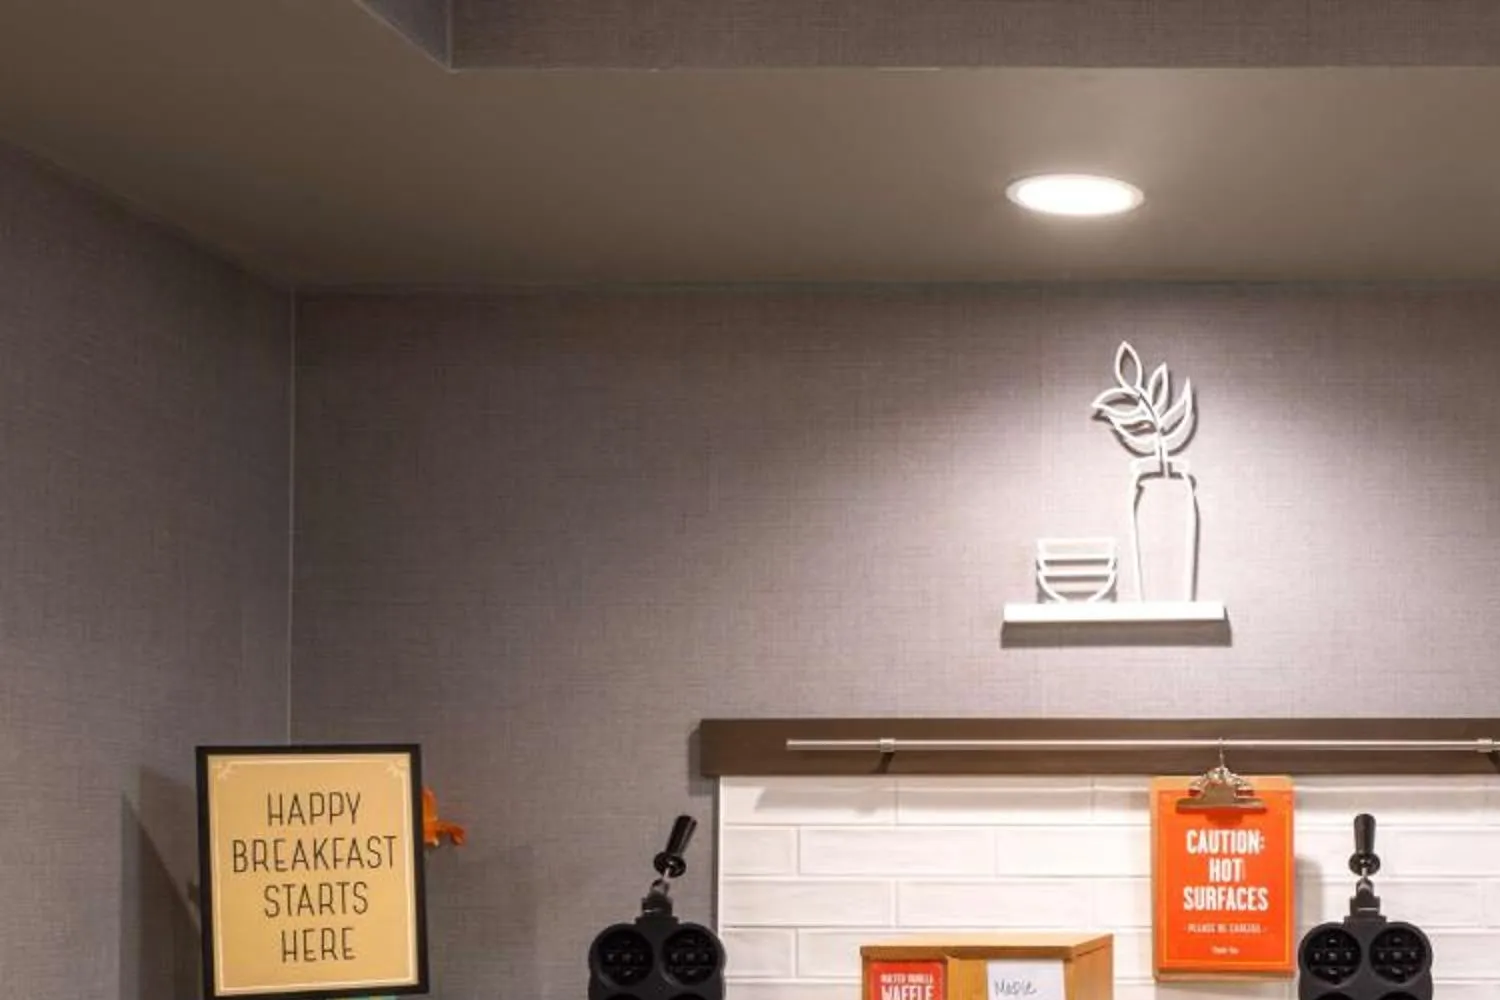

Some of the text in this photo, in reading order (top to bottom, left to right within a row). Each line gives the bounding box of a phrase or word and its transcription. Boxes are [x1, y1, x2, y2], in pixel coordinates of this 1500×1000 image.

[266, 791, 361, 826] HAPPY
[232, 835, 396, 873] BREAKFAST
[1186, 829, 1265, 854] CAUTION:
[1209, 857, 1244, 882] HOT
[263, 881, 369, 918] STARTS
[1183, 886, 1269, 911] SURFACES
[281, 926, 356, 963] HERE
